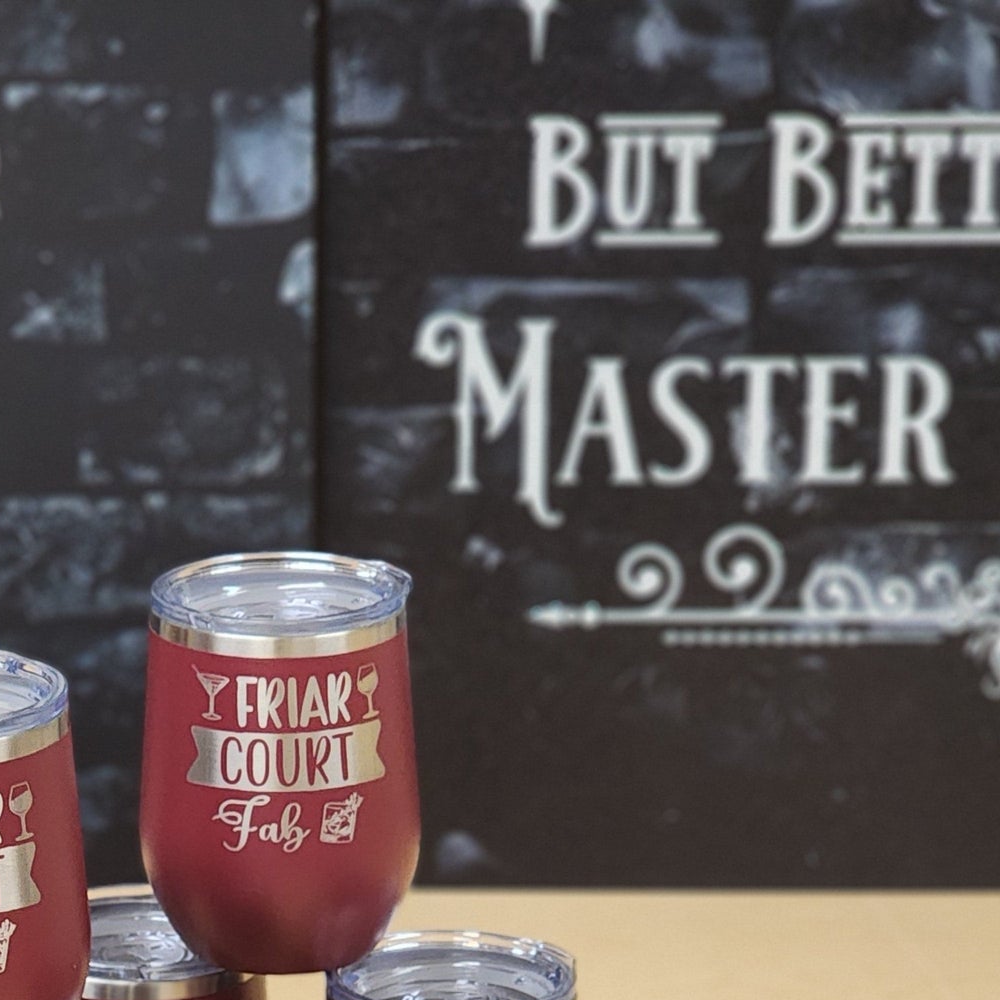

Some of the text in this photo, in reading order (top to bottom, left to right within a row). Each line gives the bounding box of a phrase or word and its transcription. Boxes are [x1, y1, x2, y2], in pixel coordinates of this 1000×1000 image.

[236, 671, 352, 729] FRIAR
[220, 732, 354, 786] COURT
[211, 795, 311, 853] Fab
